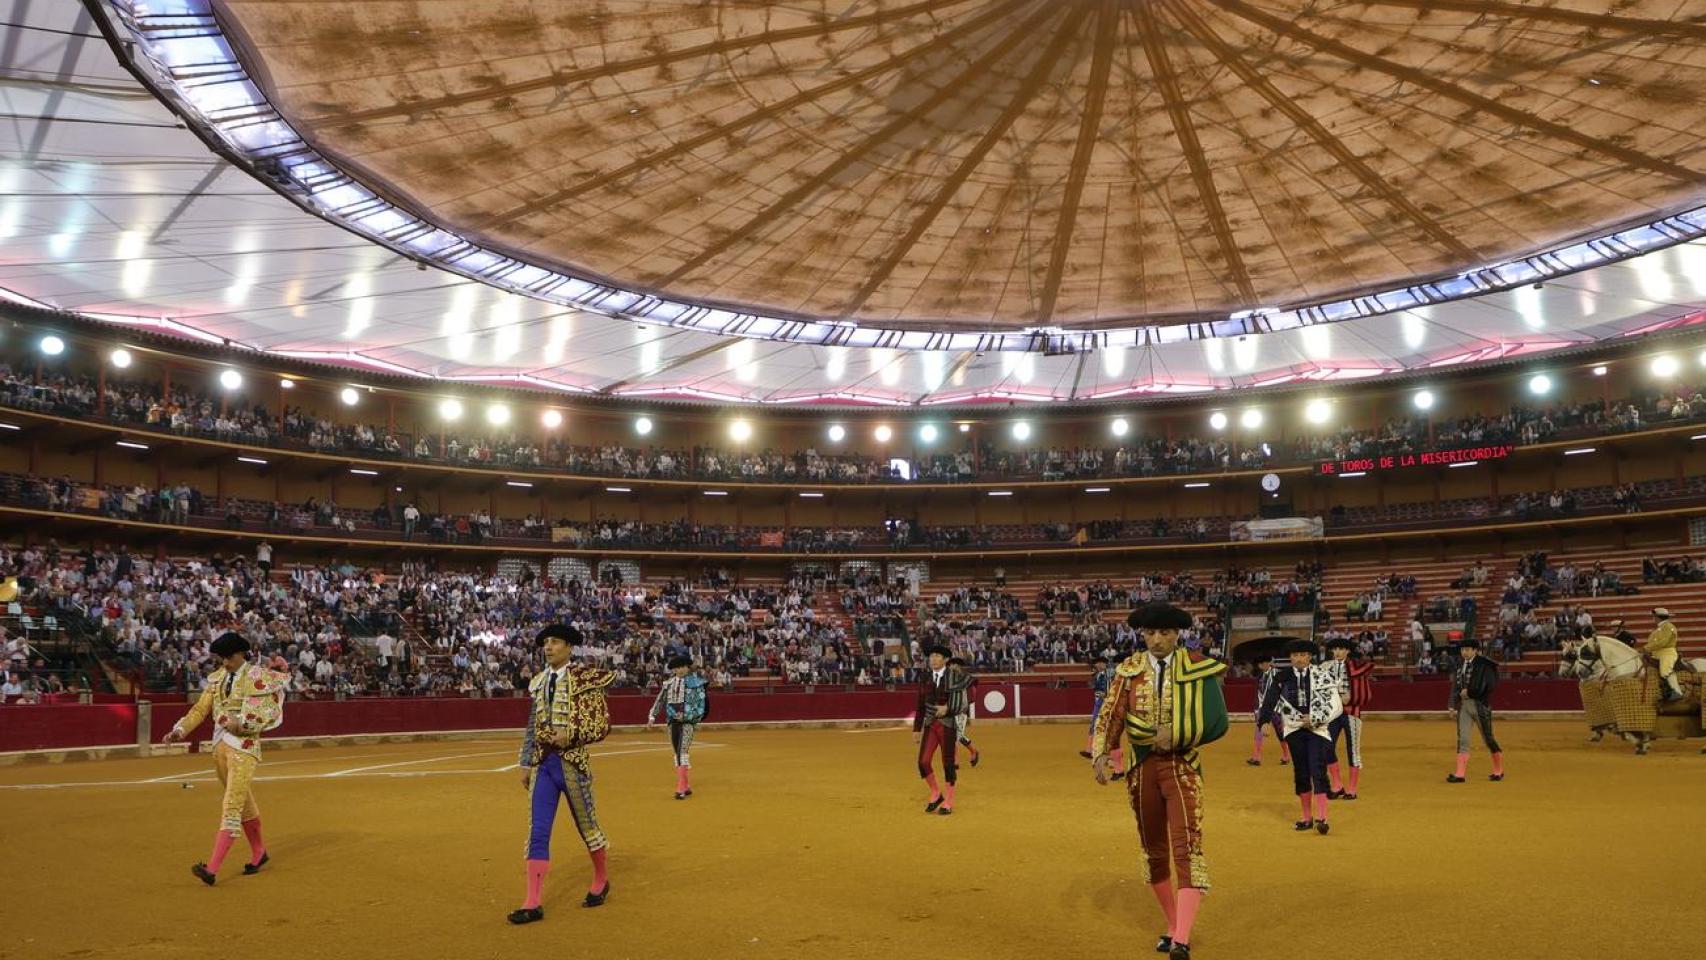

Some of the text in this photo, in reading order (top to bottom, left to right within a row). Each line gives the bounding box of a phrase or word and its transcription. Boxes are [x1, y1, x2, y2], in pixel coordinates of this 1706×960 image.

[1321, 463, 1335, 474] DE
[1341, 460, 1374, 472] TOROS
[1380, 457, 1394, 469] DE
[1401, 455, 1415, 467] LA
